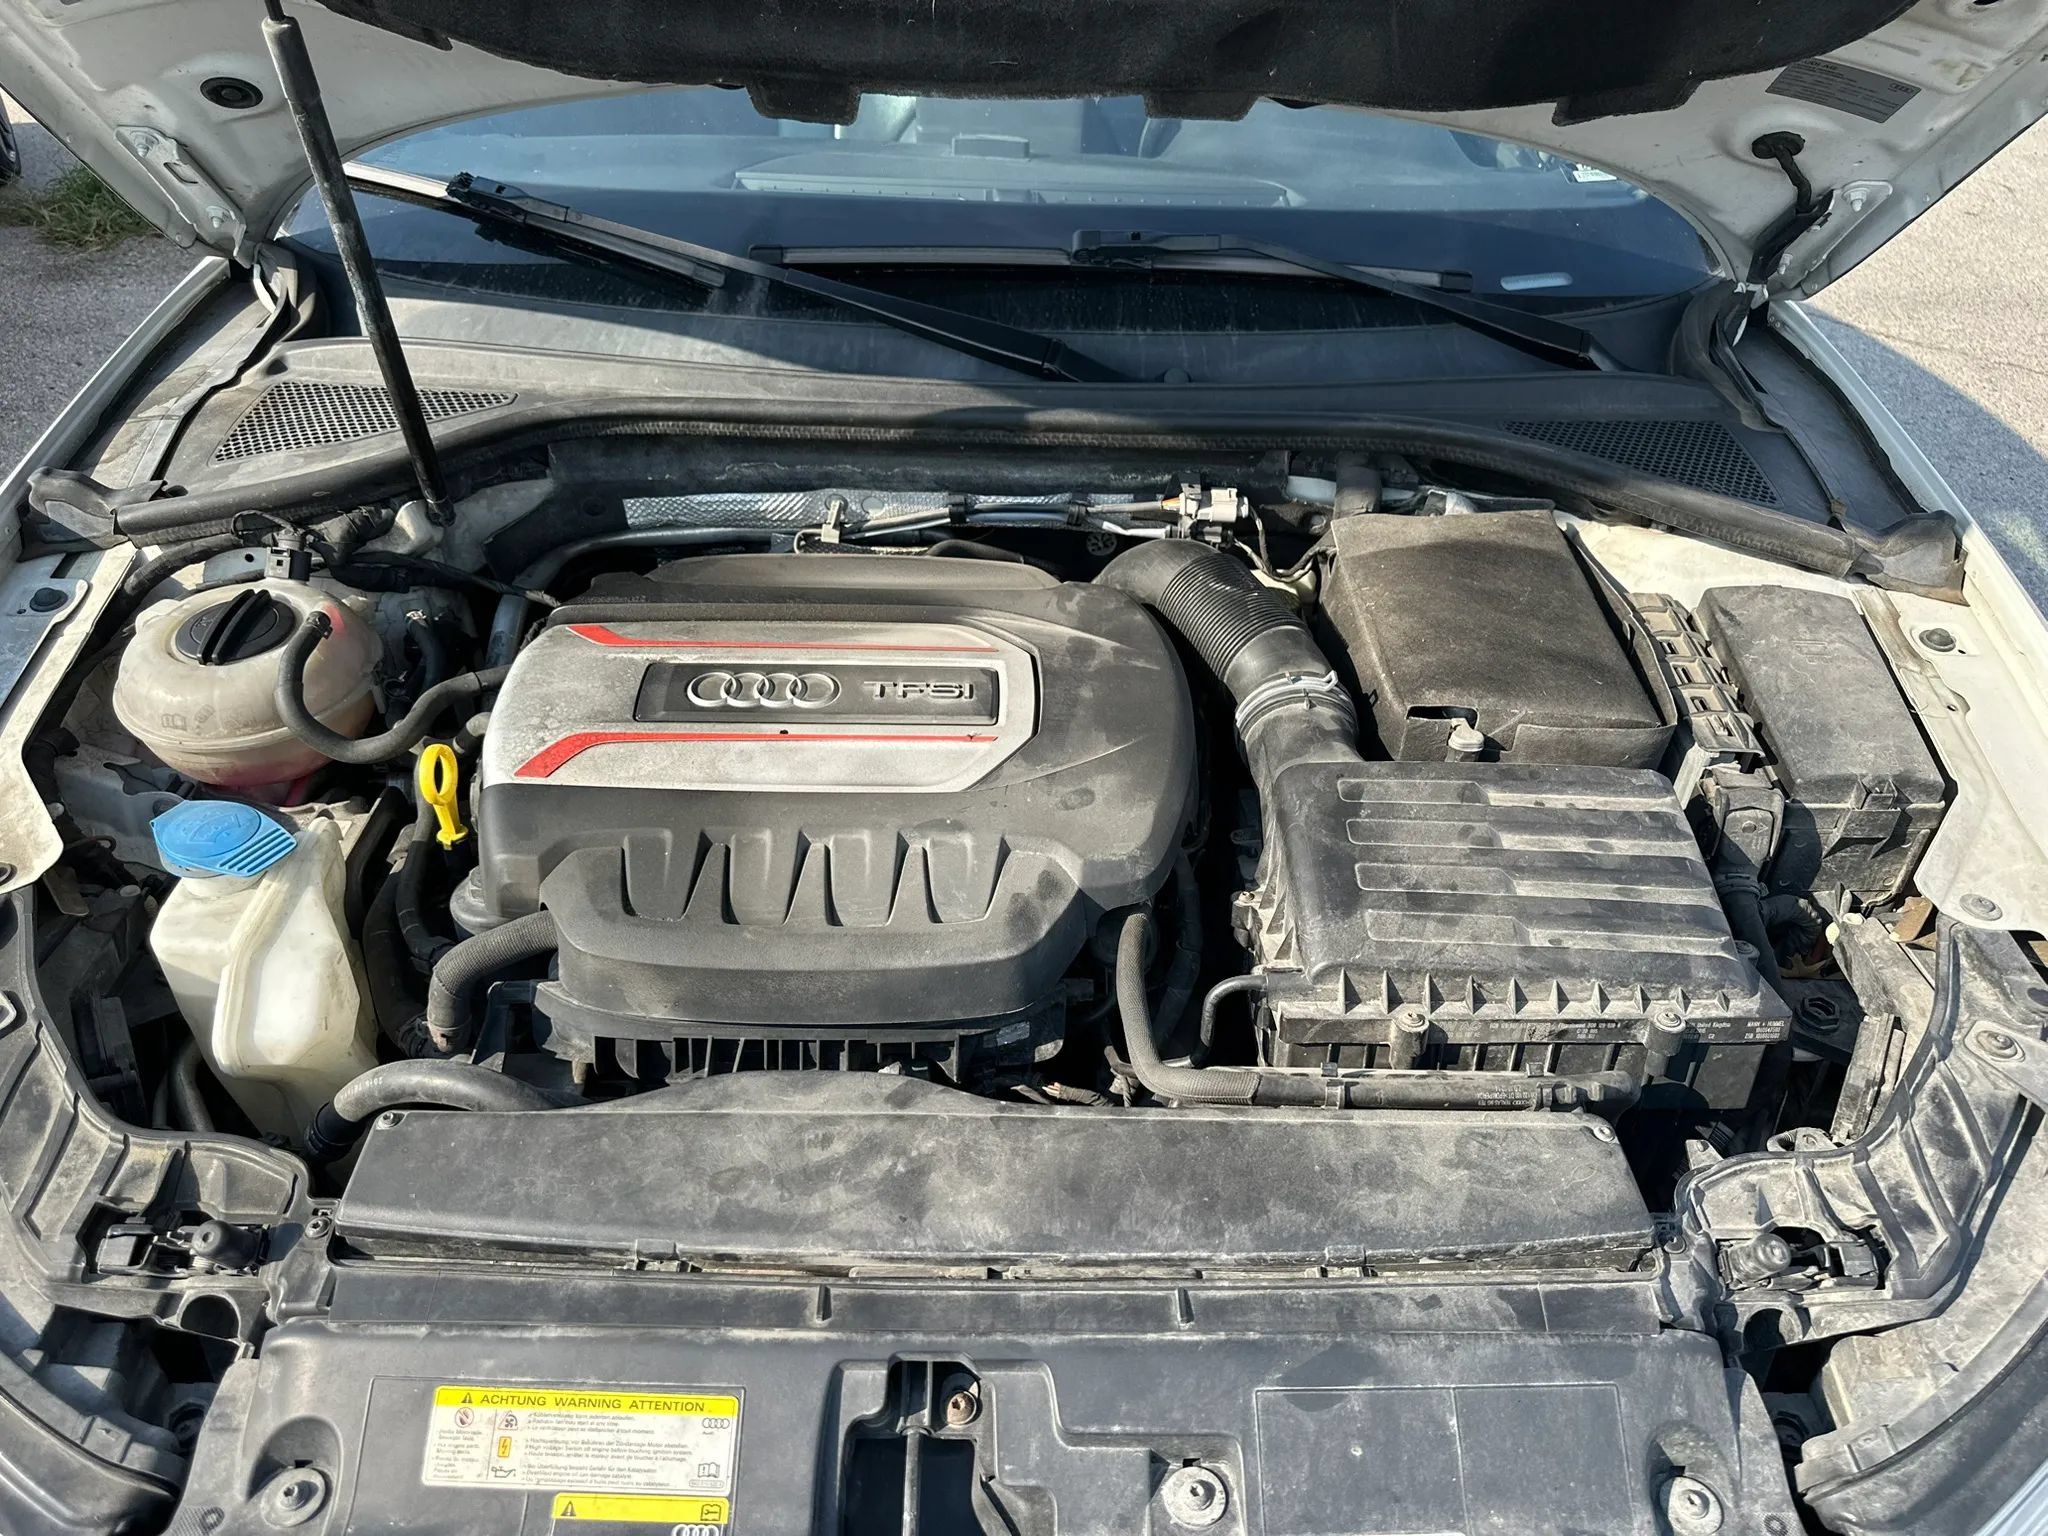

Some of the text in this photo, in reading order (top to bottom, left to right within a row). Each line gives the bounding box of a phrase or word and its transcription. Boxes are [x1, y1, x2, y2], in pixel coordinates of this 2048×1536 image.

[863, 681, 974, 699] TFSI
[480, 1394, 705, 1412] ACHTUNG WARNING ATTENTION
